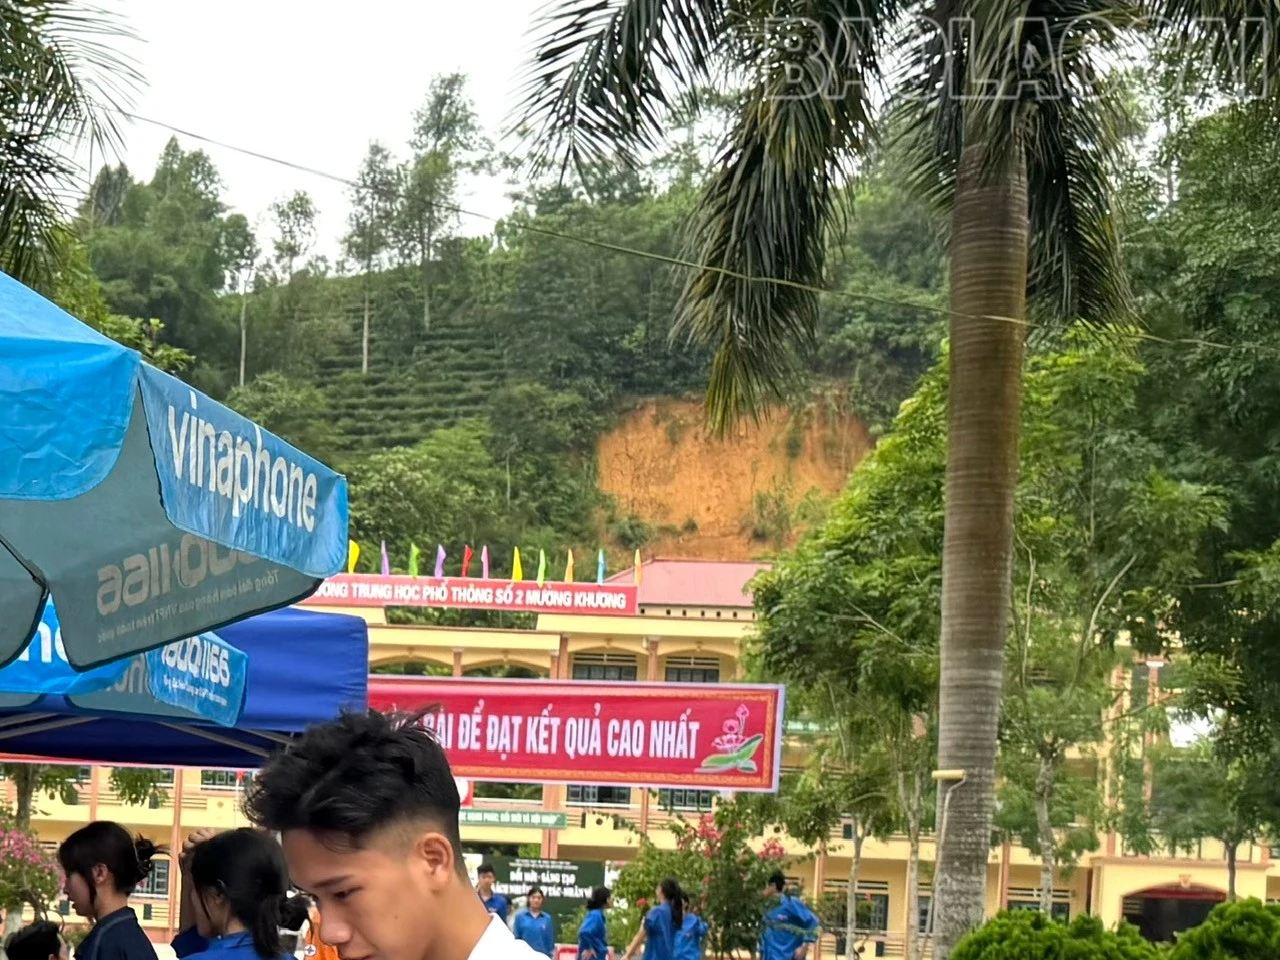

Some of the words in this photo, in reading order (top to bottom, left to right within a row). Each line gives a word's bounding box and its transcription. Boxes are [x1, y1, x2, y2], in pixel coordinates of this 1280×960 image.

[167, 389, 318, 533] vinaphone
[352, 583, 393, 601] TRUNG
[394, 585, 422, 603] HỌC
[422, 577, 448, 603] PHỔ
[452, 583, 492, 605] THÔNG
[494, 582, 514, 605] SỐ
[515, 589, 524, 605] 2
[526, 583, 572, 607] MƯỜNG
[573, 590, 627, 610] KHƯƠNG
[457, 698, 485, 750] ĐỂ
[486, 713, 523, 761] ĐẠT
[526, 703, 561, 755] KẾT
[564, 702, 601, 759] QUẢ
[606, 719, 643, 758] CAO
[649, 708, 700, 760] NHẤT
